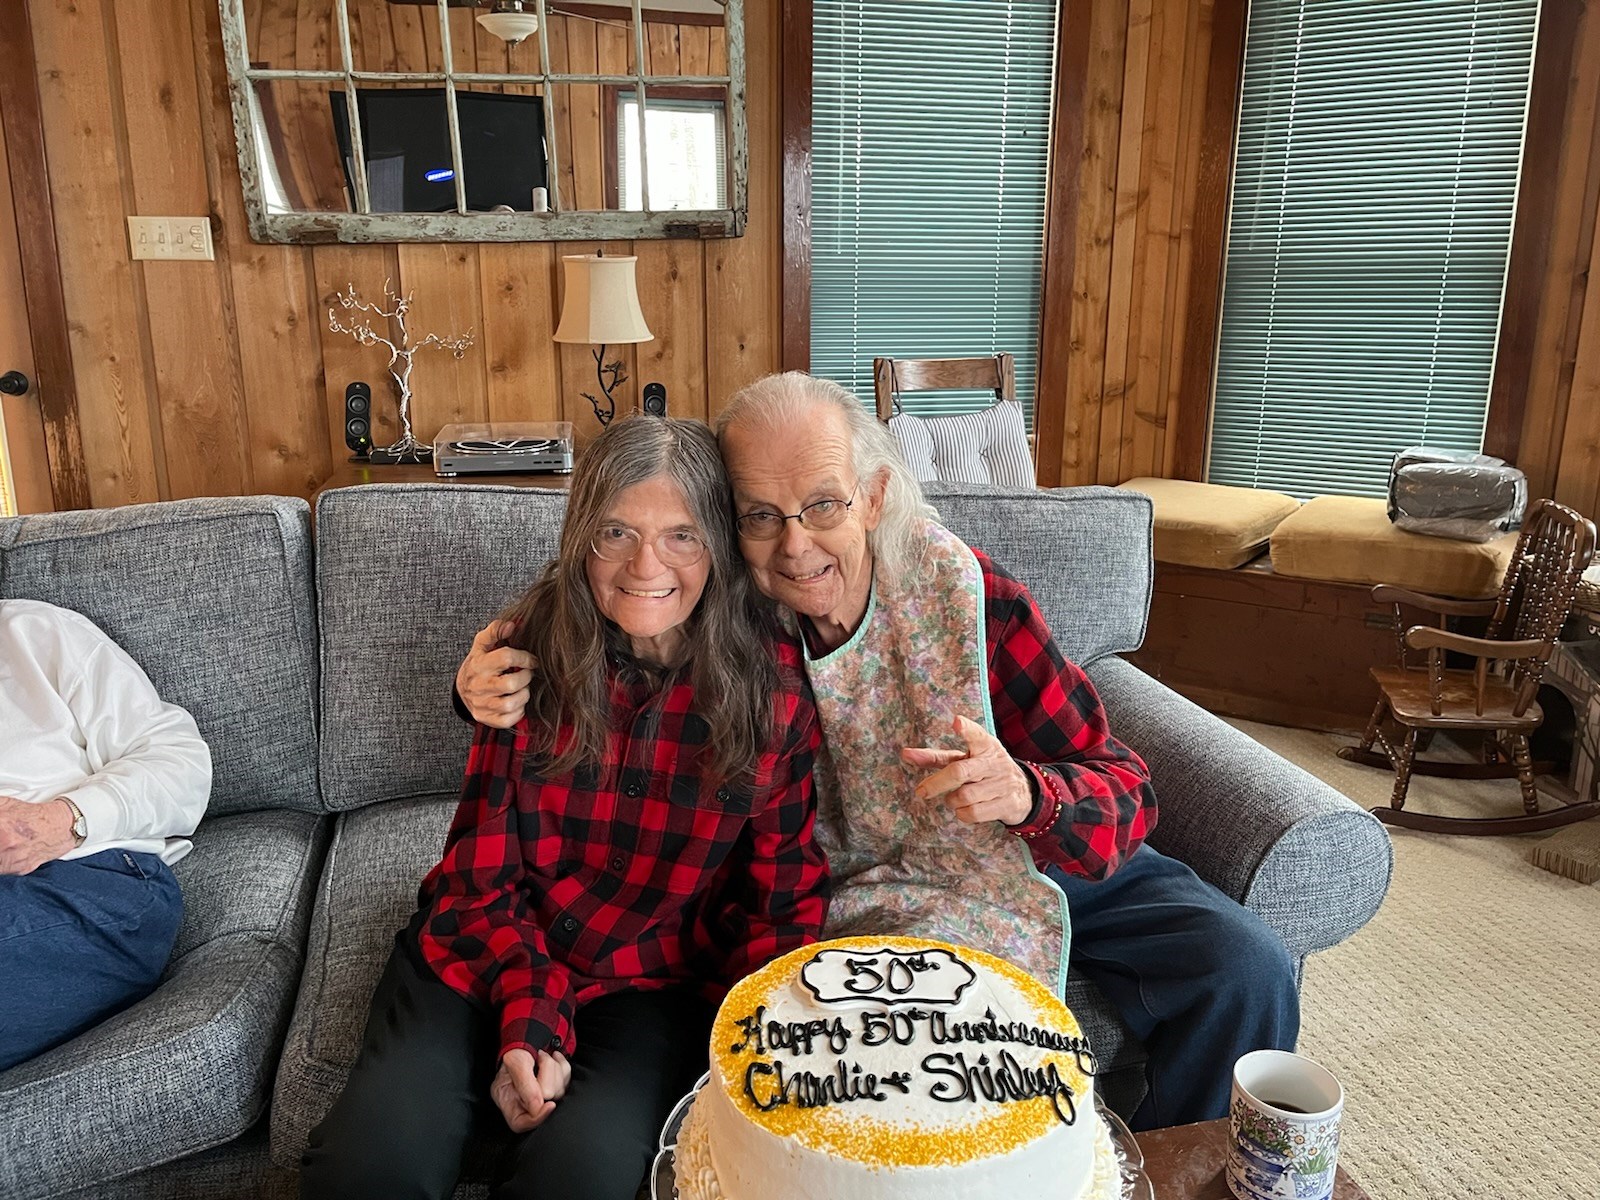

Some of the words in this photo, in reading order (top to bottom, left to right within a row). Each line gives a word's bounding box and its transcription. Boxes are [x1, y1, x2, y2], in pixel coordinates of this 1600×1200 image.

[843, 953, 941, 995] 50th
[730, 1005, 852, 1056] Happy
[743, 1058, 888, 1112] Charlie
[920, 1049, 1077, 1126] Shirley
